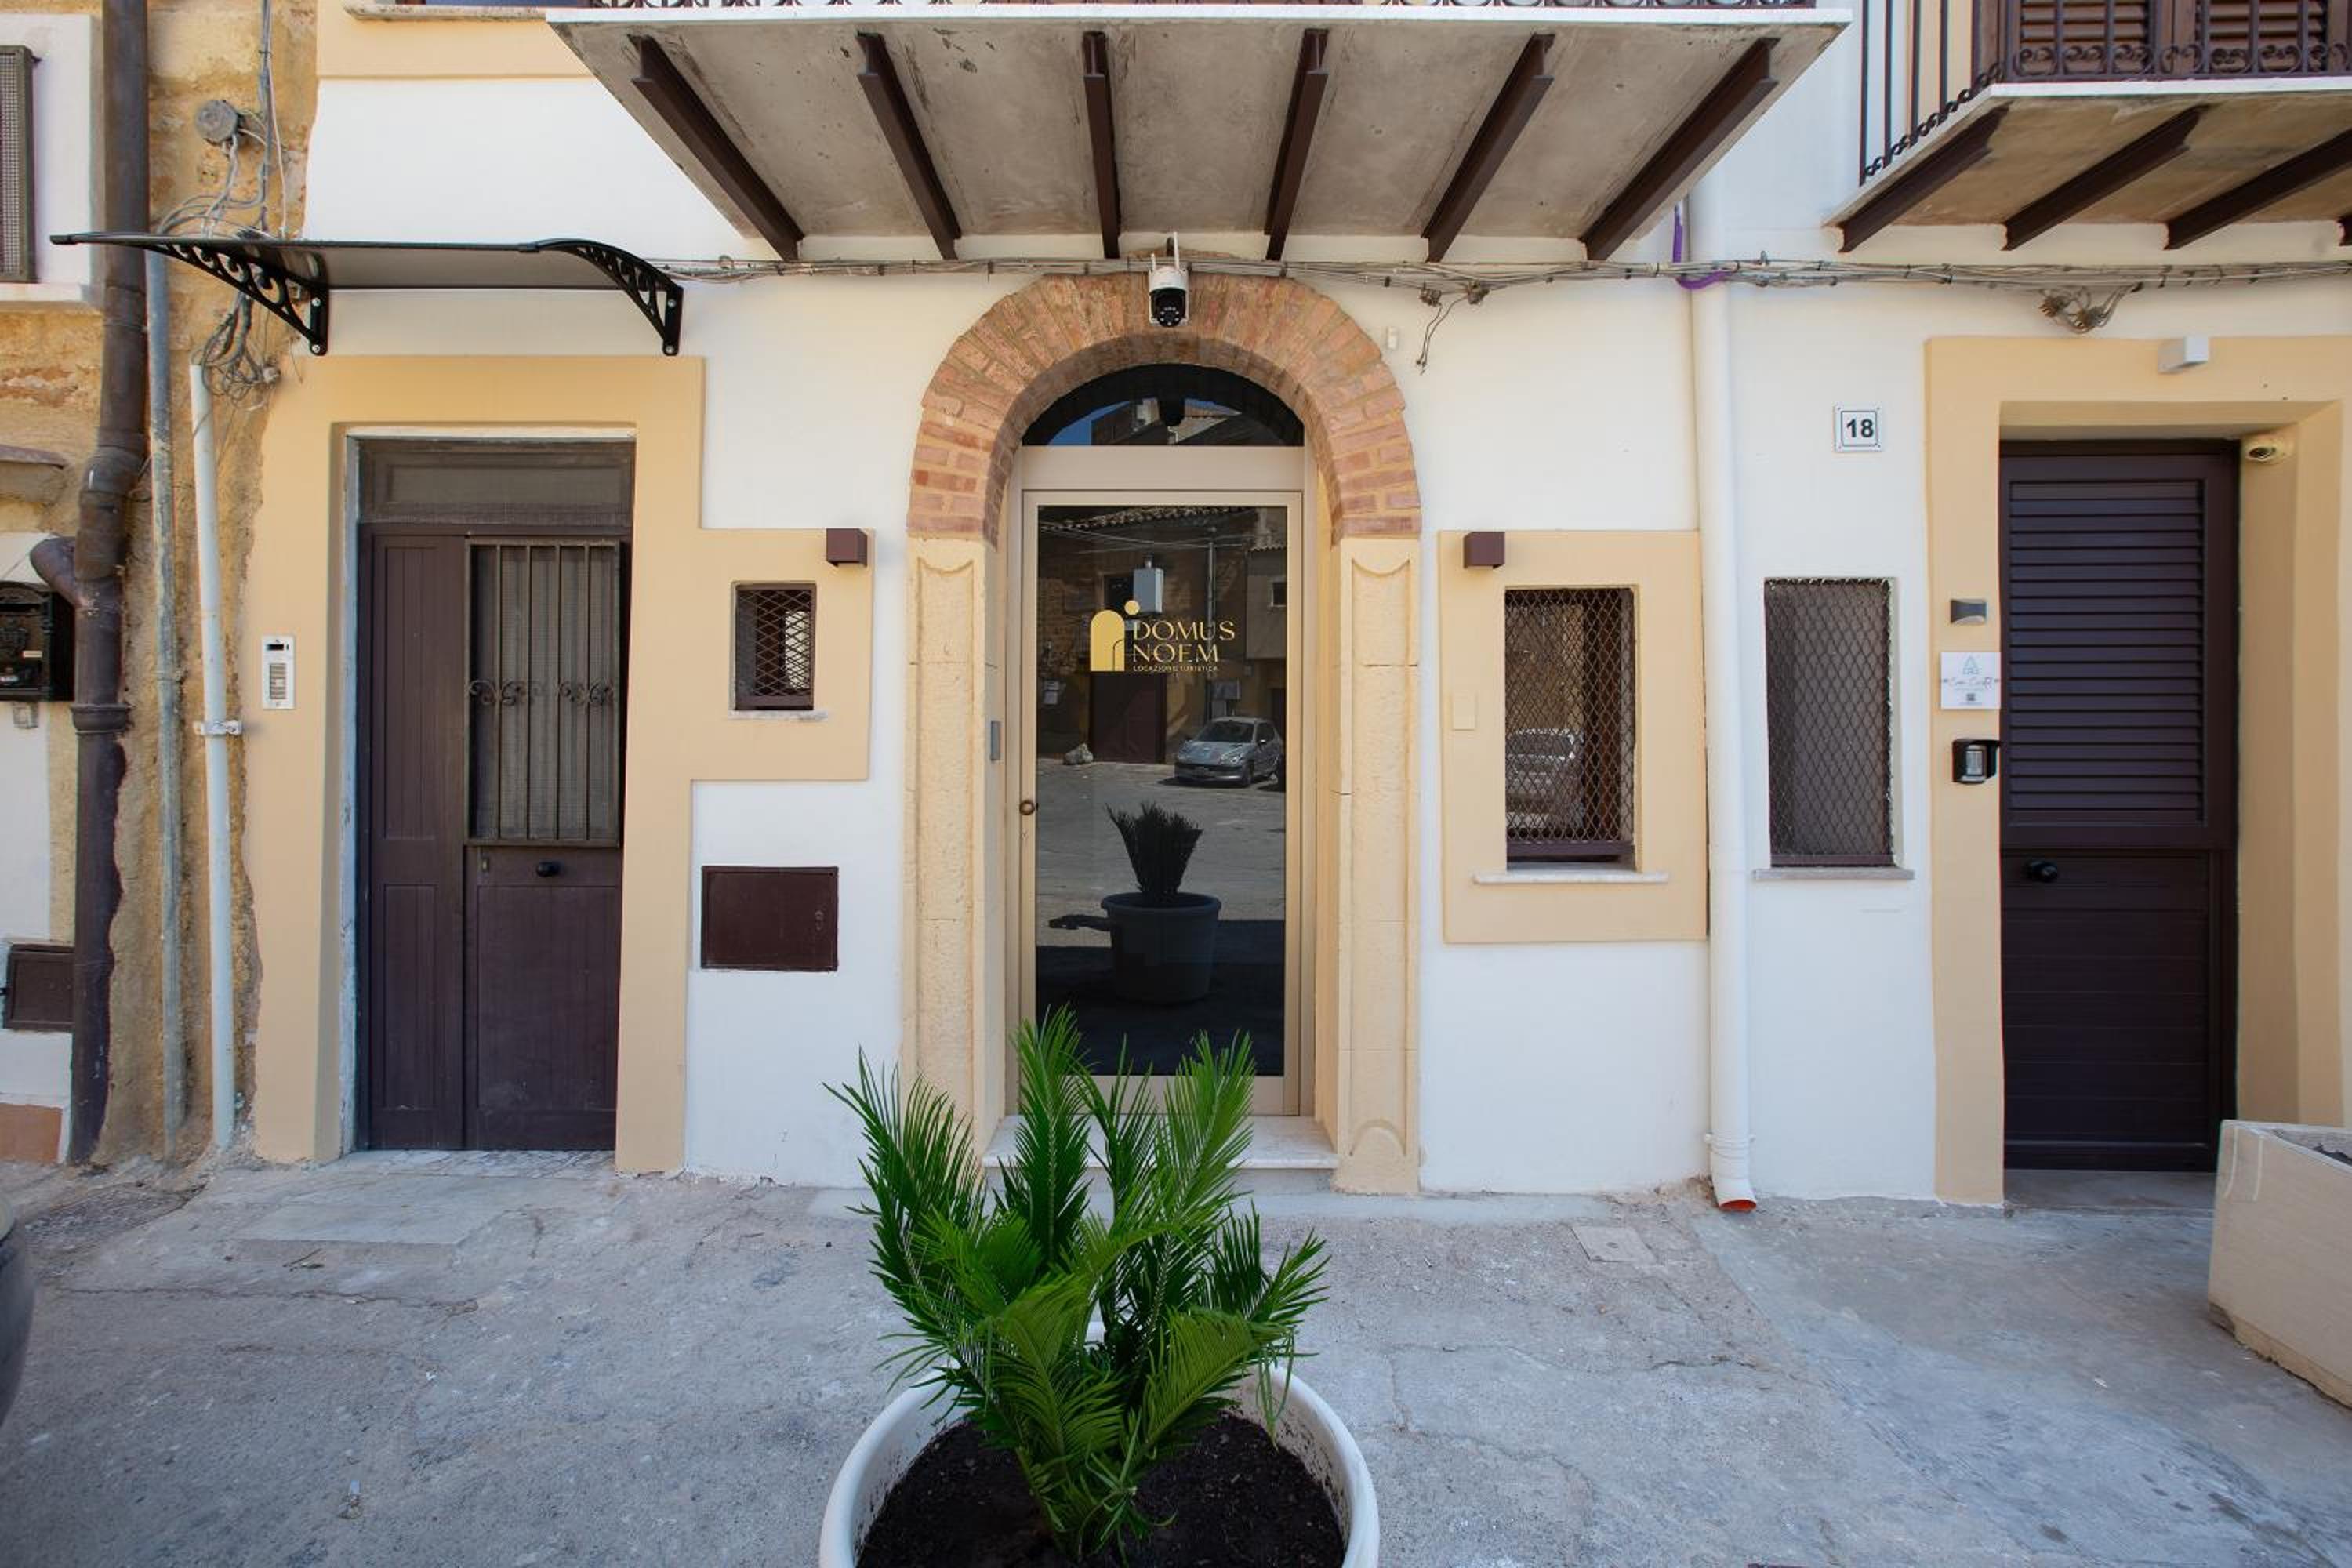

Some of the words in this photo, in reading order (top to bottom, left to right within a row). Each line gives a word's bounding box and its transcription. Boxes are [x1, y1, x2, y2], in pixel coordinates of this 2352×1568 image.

[1846, 419, 1874, 438] 18
[1133, 620, 1236, 641] DOMUS
[1133, 643, 1219, 662] NOEM
